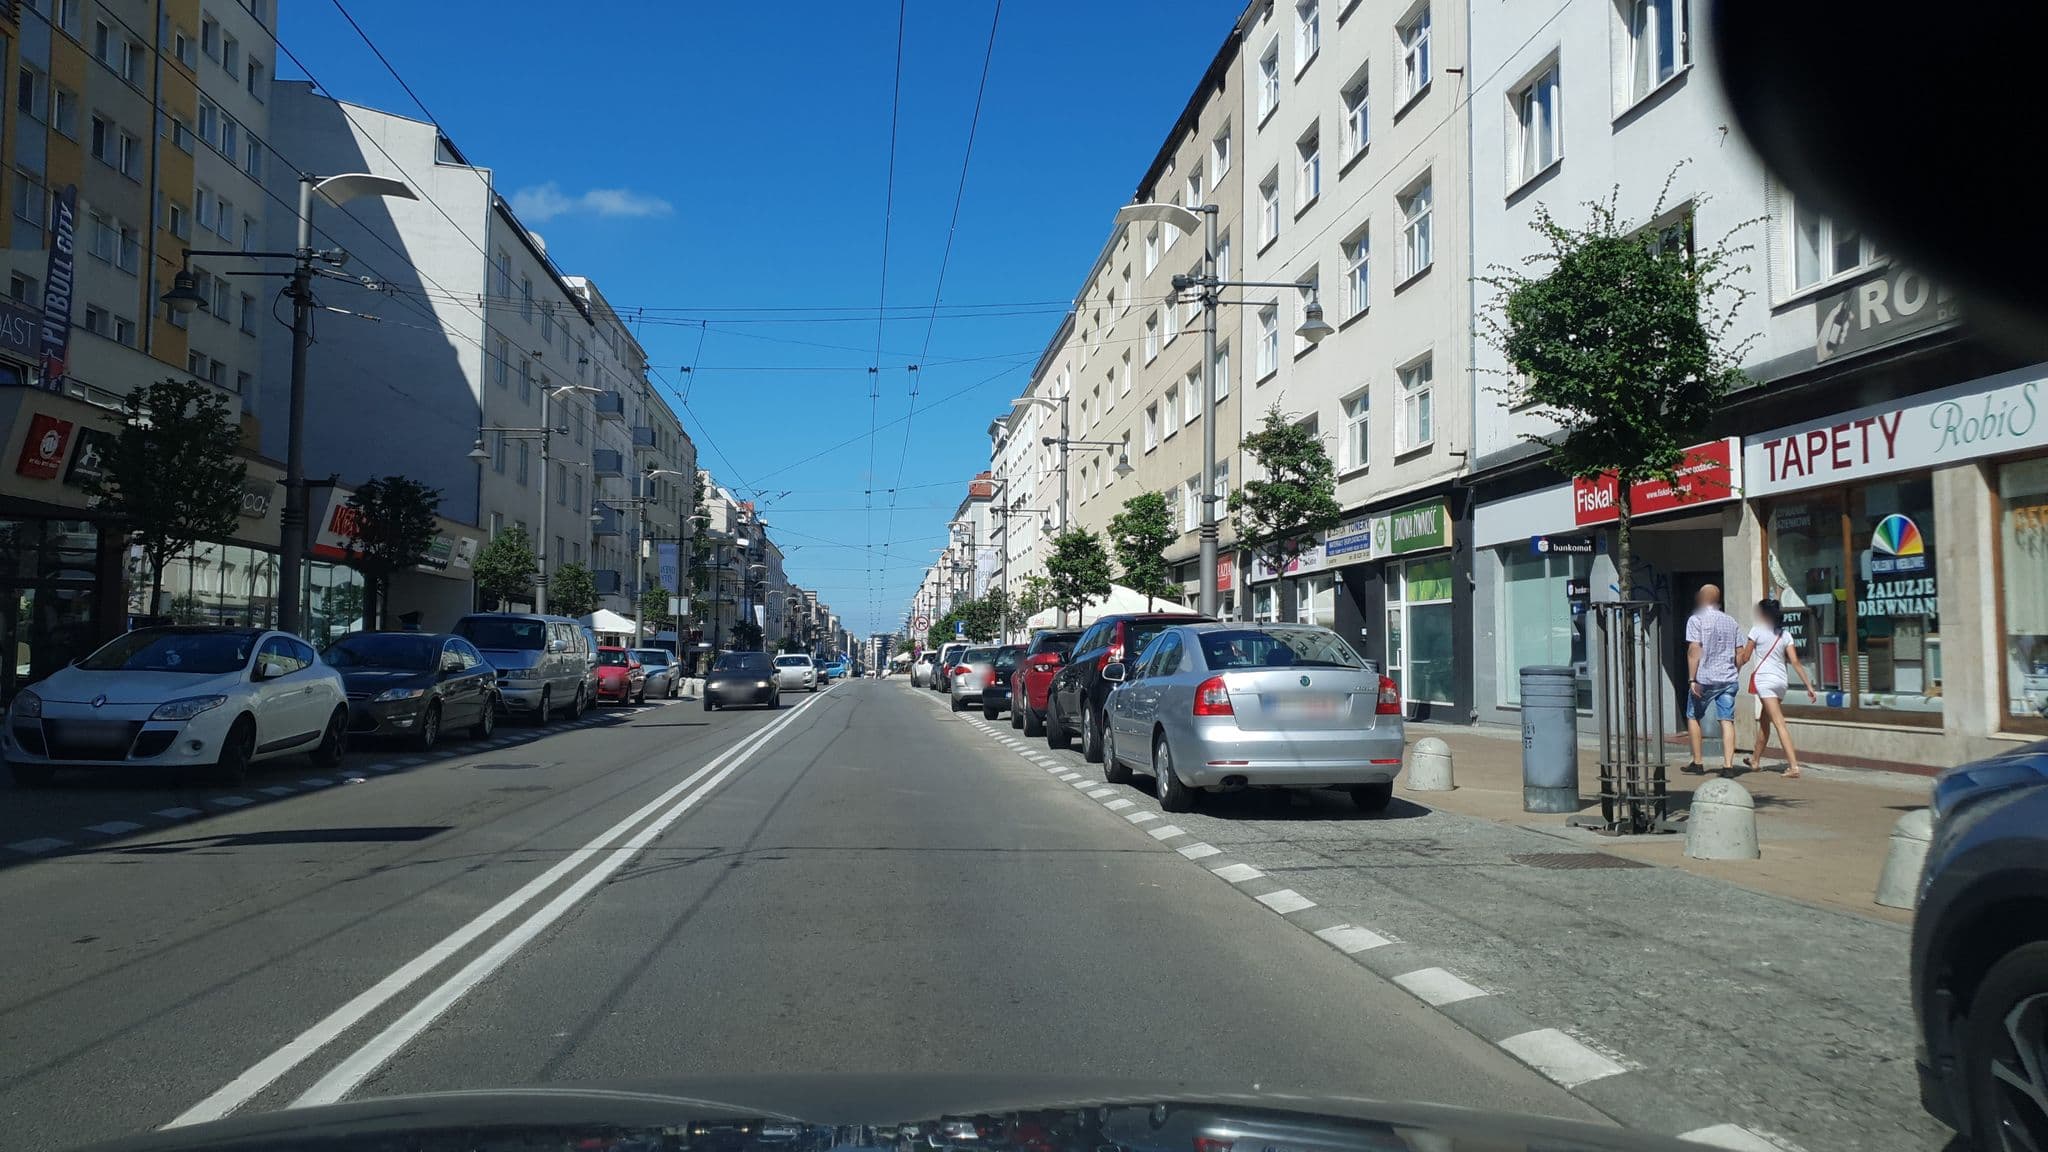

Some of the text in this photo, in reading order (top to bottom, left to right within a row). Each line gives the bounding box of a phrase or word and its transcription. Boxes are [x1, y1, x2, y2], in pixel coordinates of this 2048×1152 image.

[42, 201, 73, 347] PITBULL CITY
[0, 312, 36, 349] AST
[1763, 384, 2039, 482] TAPETY RobiS
[1577, 483, 1613, 513] Fiskal
[1553, 543, 1592, 552] bankomat
[1867, 578, 1936, 600] ŻALUZJE
